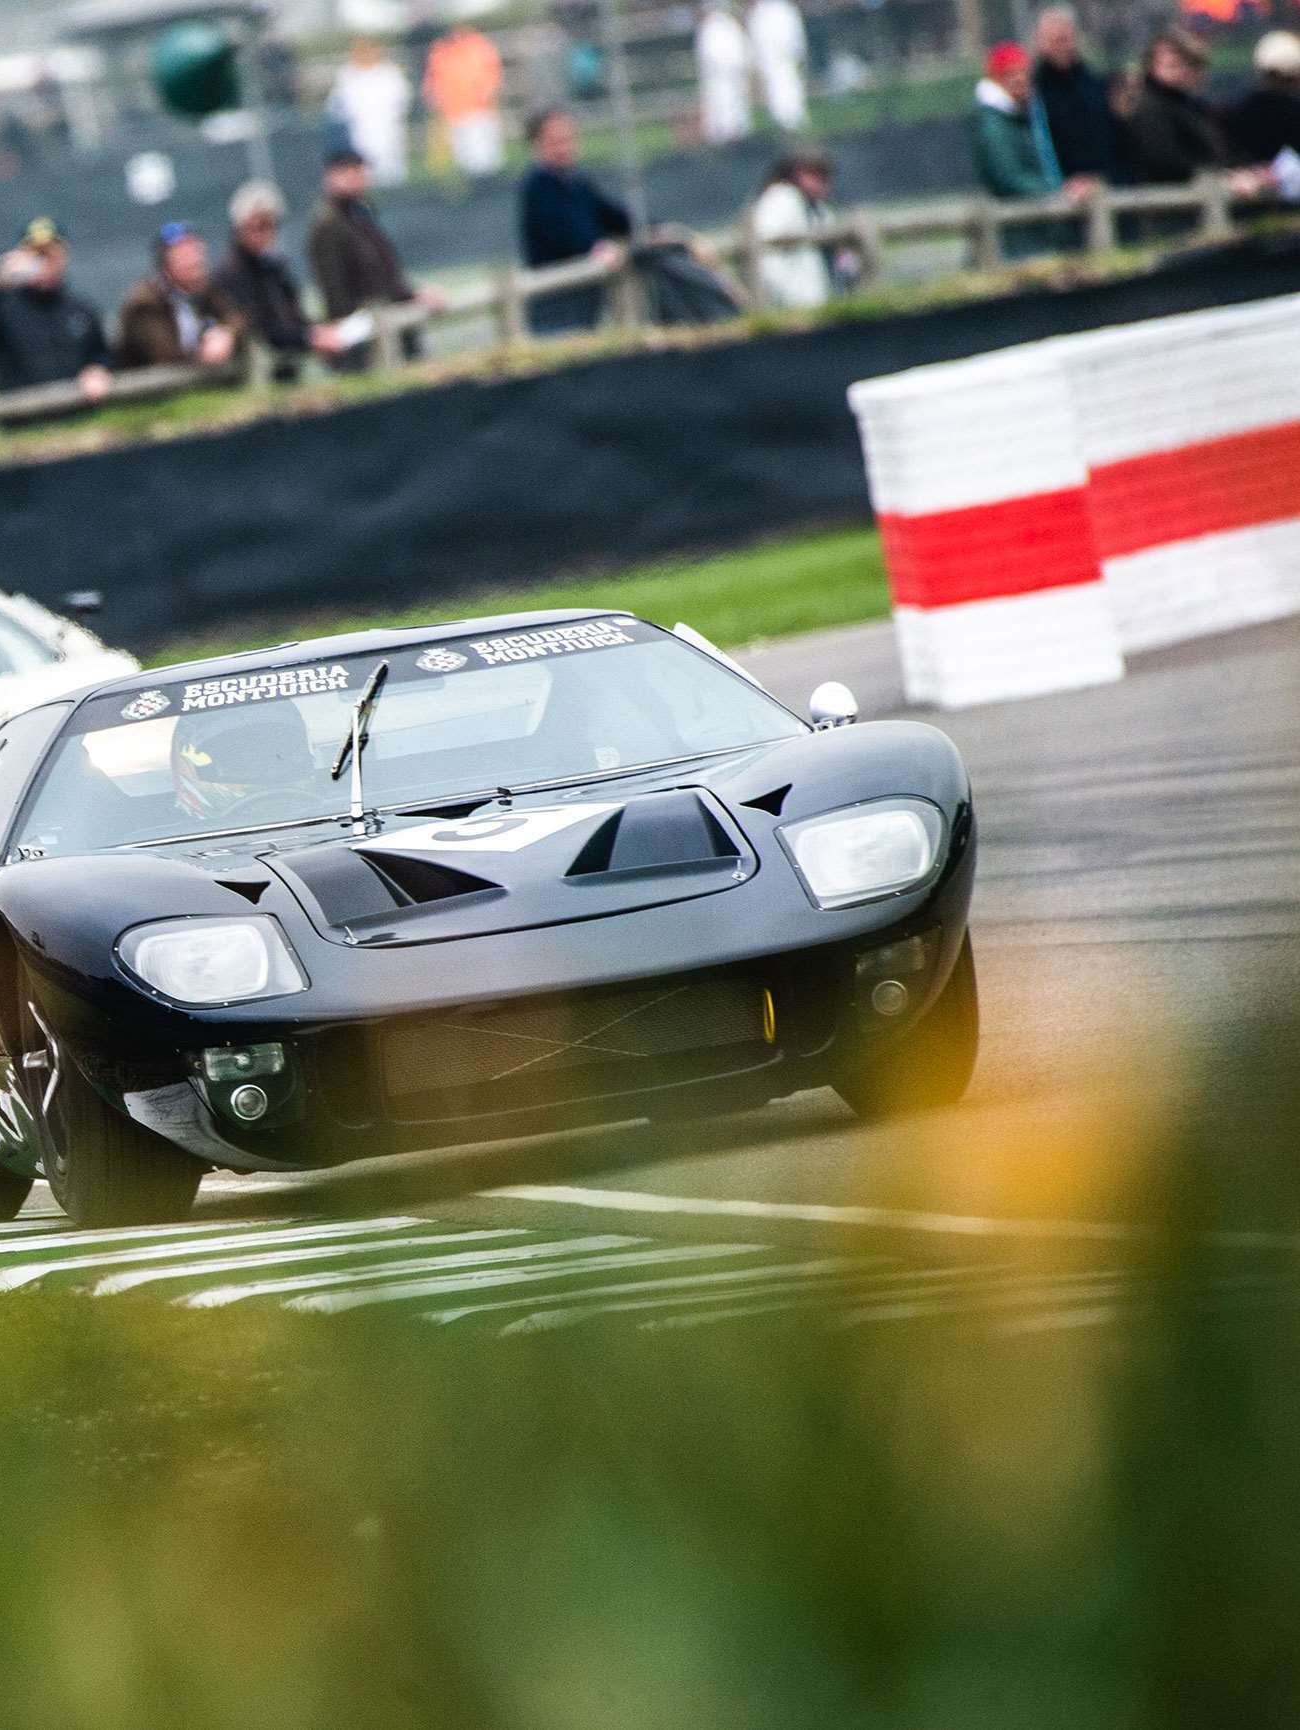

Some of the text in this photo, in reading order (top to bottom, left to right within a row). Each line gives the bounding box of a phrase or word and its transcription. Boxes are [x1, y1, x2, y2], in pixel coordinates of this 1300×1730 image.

[469, 621, 622, 655] ESCUDERIA
[479, 631, 636, 665] MONTJUICH
[180, 675, 350, 712] MONTJUICH
[183, 664, 350, 699] ESCUDERIA
